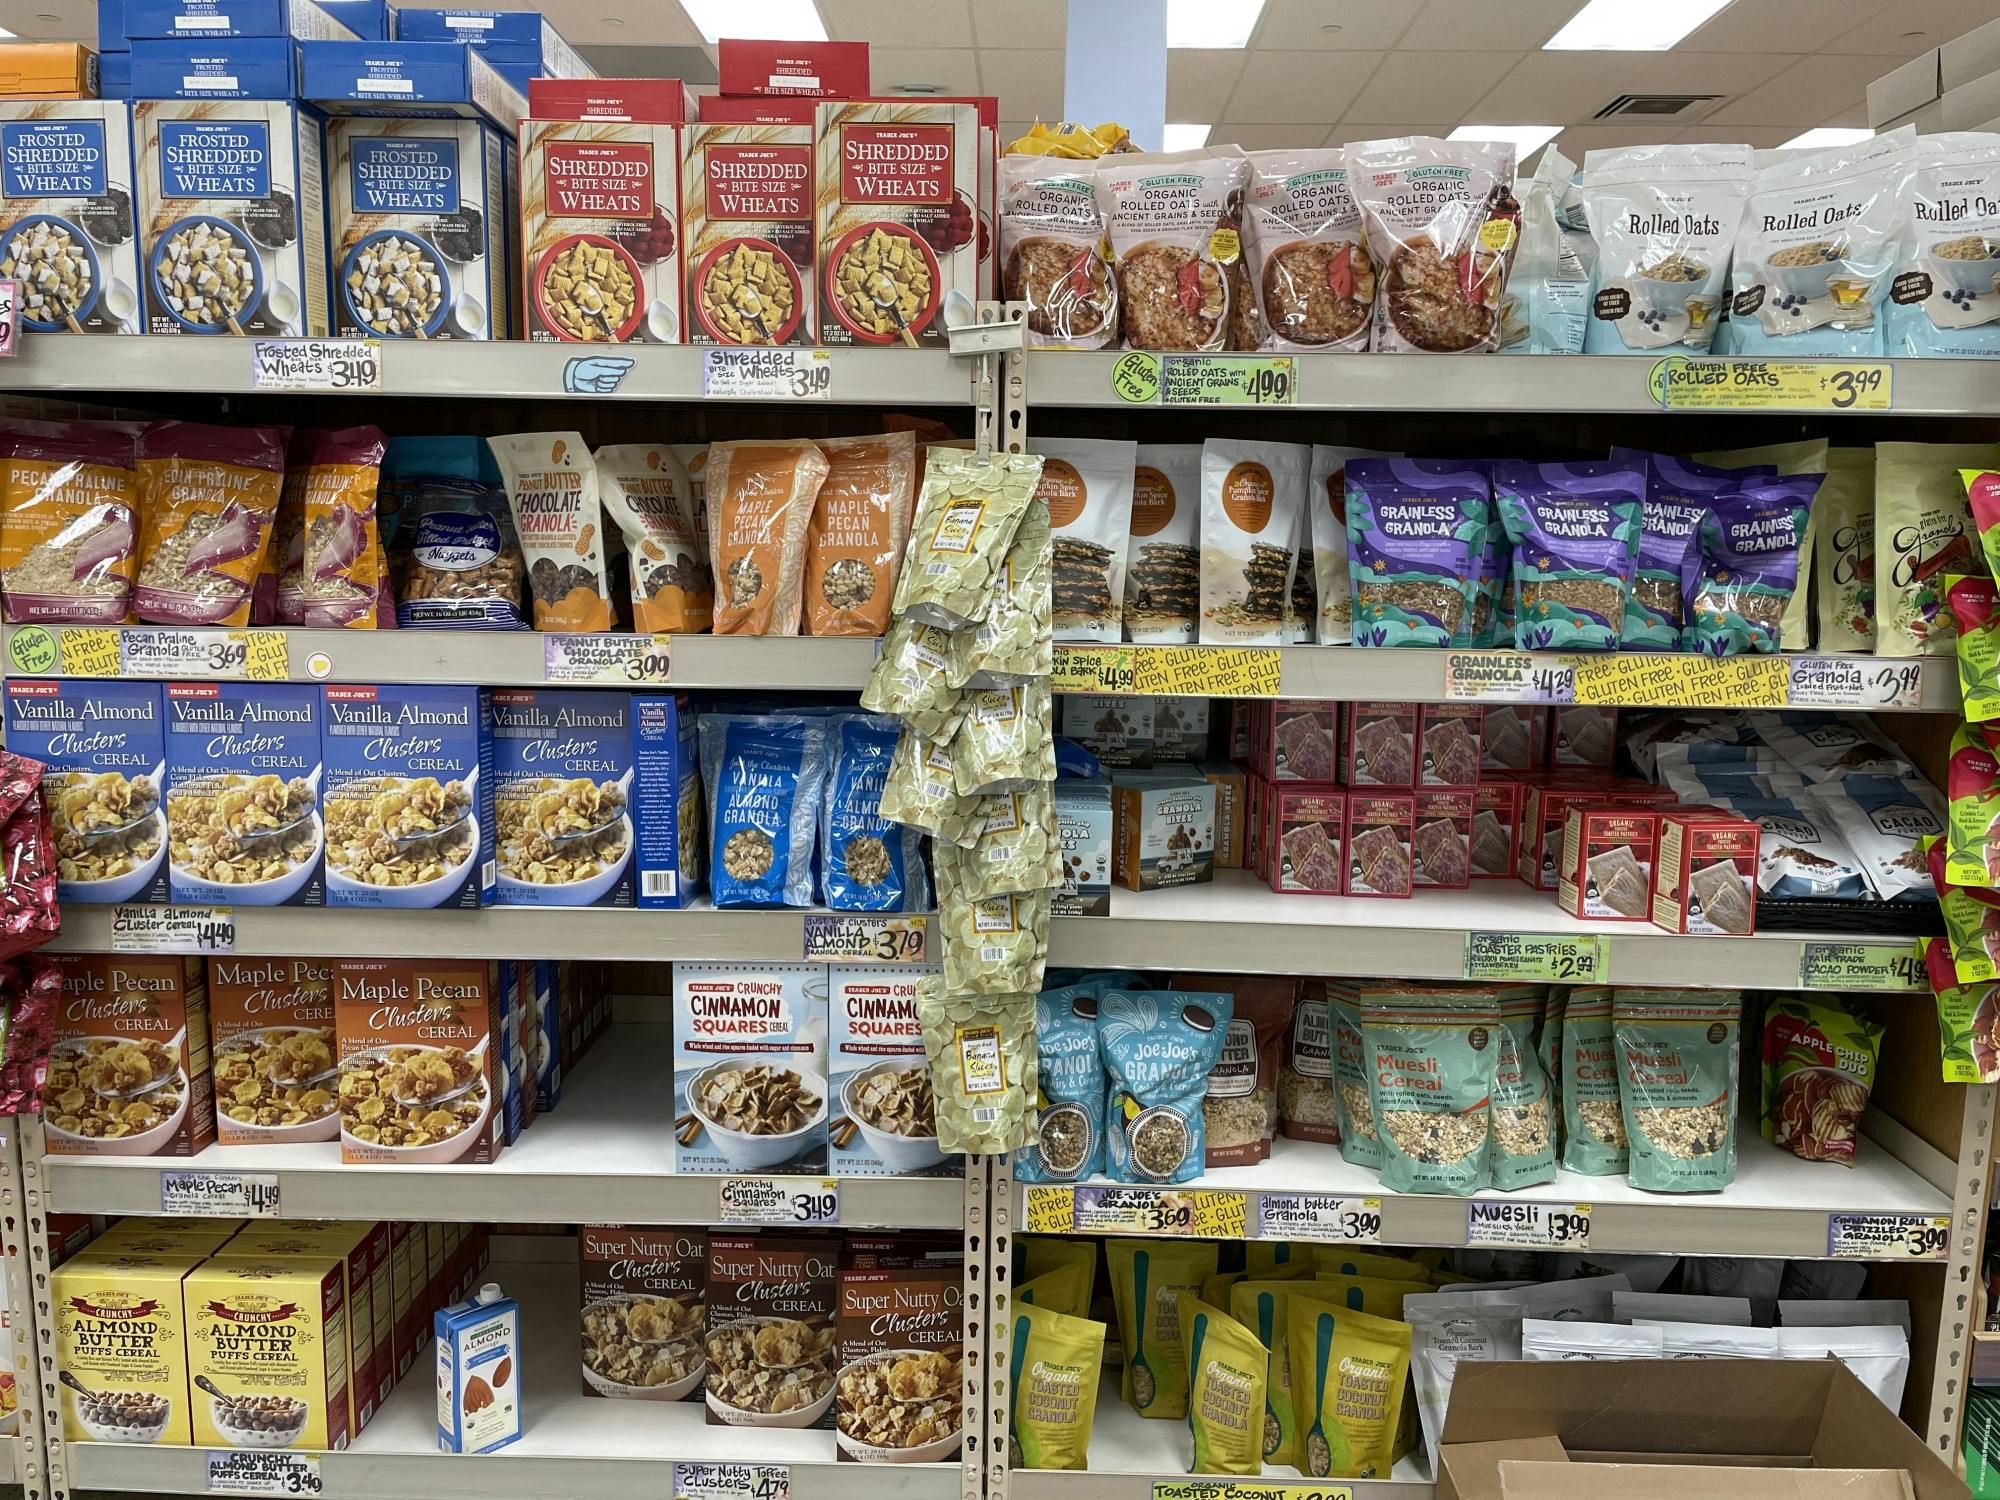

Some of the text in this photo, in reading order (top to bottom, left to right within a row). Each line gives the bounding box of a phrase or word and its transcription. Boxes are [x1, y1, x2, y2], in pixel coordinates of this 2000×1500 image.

[796, 88, 824, 96] WHEATS
[179, 135, 249, 148] FROSTED
[167, 147, 262, 164] SHREDDED
[846, 141, 949, 160] SHREDDED
[868, 163, 926, 175] BITE SIZE
[176, 175, 255, 192] WHEATS
[855, 176, 939, 196] WHEATS
[1146, 177, 1197, 187] GLUTEN FREE
[1145, 188, 1197, 199] ORGANIC
[1121, 199, 1201, 211] ROLLED OATS
[1112, 211, 1188, 221] ANCIENT GRAINS
[1762, 201, 1862, 233] Rolled Oats
[1629, 214, 1719, 236] Rolled Oats
[255, 343, 372, 359] Frosted Shredded
[710, 351, 795, 366] Shredded
[1171, 358, 1211, 367] organic
[260, 360, 322, 377] Wheats
[740, 365, 794, 379] Wheats
[1124, 356, 1157, 387] Gluten
[1167, 368, 1198, 377] ROLLED
[1200, 368, 1227, 377] OATS
[1686, 362, 1767, 373] GLUTEN FREE
[1115, 371, 1142, 398] Free
[1165, 378, 1239, 387] ANCIENT GRAINS
[1668, 371, 1780, 386] ROLLED OATS
[518, 473, 581, 490] PEANUT BUTTER
[515, 491, 581, 512] CHOCOLATE
[828, 501, 869, 514] MAPLE
[1380, 505, 1455, 520] GRAINLESS
[521, 514, 571, 533] GRANOLA
[828, 516, 870, 530] PECAN
[1385, 522, 1451, 536] GRANOLA
[820, 532, 879, 547] GRANOLA
[13, 634, 48, 650] Gluten
[122, 631, 196, 645] Pecan Praline
[552, 638, 653, 648] PEANUT BUTTER
[127, 644, 179, 657] Granola
[564, 647, 644, 658] CHOCOLATE
[20, 652, 51, 670] Free
[569, 657, 624, 666] GRANOLA
[1450, 655, 1532, 669] GRAINLESS
[1800, 661, 1855, 669] GLUTEN FREE
[1452, 669, 1523, 681] GRANOLA
[1792, 670, 1861, 683] Granola
[172, 701, 312, 723] Vanilla Almond
[641, 708, 664, 716] Vanilla
[641, 719, 666, 727] Almond
[207, 736, 285, 758] Clusters
[251, 756, 308, 768] CEREAL
[1967, 759, 1992, 768] TRADER
[1157, 803, 1202, 815] GRANOLA
[1609, 820, 1634, 828] ORGANIC
[1880, 817, 1933, 829] CACAO
[805, 926, 864, 937] VANILLA
[805, 937, 870, 949] ALMOND
[1477, 936, 1520, 946] organic
[1473, 943, 1521, 955] TOASTER
[1807, 965, 1890, 975] CACAO POWDER
[340, 978, 481, 1003] Maple Pecan
[737, 982, 783, 996] CRUNCHY
[690, 996, 781, 1019] CINNAMON
[369, 1005, 452, 1031] Clusters
[417, 1026, 477, 1039] CEREAL
[693, 1019, 789, 1036] SQUARES CEREAL
[1791, 1033, 1869, 1065] APPLE CHIP
[1377, 1054, 1437, 1074] Muesli
[1839, 1060, 1868, 1076] DUO
[1378, 1071, 1442, 1091] Cereal
[166, 1179, 243, 1194] Maple Pecan
[722, 1187, 785, 1200] Cinnamon
[1097, 1200, 1168, 1209] GRANOLA
[1262, 1197, 1343, 1210] almond butter
[1264, 1209, 1318, 1221] Granola
[1470, 1204, 1538, 1223] Muesli
[1833, 1216, 1927, 1226] CINNAMON ROLL
[1843, 1225, 1908, 1234] DRIZZLED
[1843, 1232, 1905, 1242] GRANOLA
[713, 1256, 835, 1280] Super Nutty Oat
[736, 1280, 811, 1302] Clusters
[96, 1308, 132, 1319] CRUNCHY
[73, 1320, 158, 1335] ALMOND
[79, 1334, 154, 1348] BUTTER
[464, 1328, 511, 1352] ALMOND
[74, 1346, 161, 1358] PUFFS CEREAL
[1339, 1357, 1389, 1379] Organic
[1338, 1374, 1389, 1393] TOASTED
[1336, 1389, 1387, 1406] COCONUT
[1335, 1403, 1385, 1420] GRANOLA
[230, 1453, 292, 1463] CRUNCHY
[210, 1461, 308, 1473] ALMOND BUTTER
[677, 1464, 788, 1480] Super Nutty Toffee
[210, 1470, 281, 1481] PUFFS CEREAL
[1154, 1485, 1286, 1500] TOASTED COCONUT
